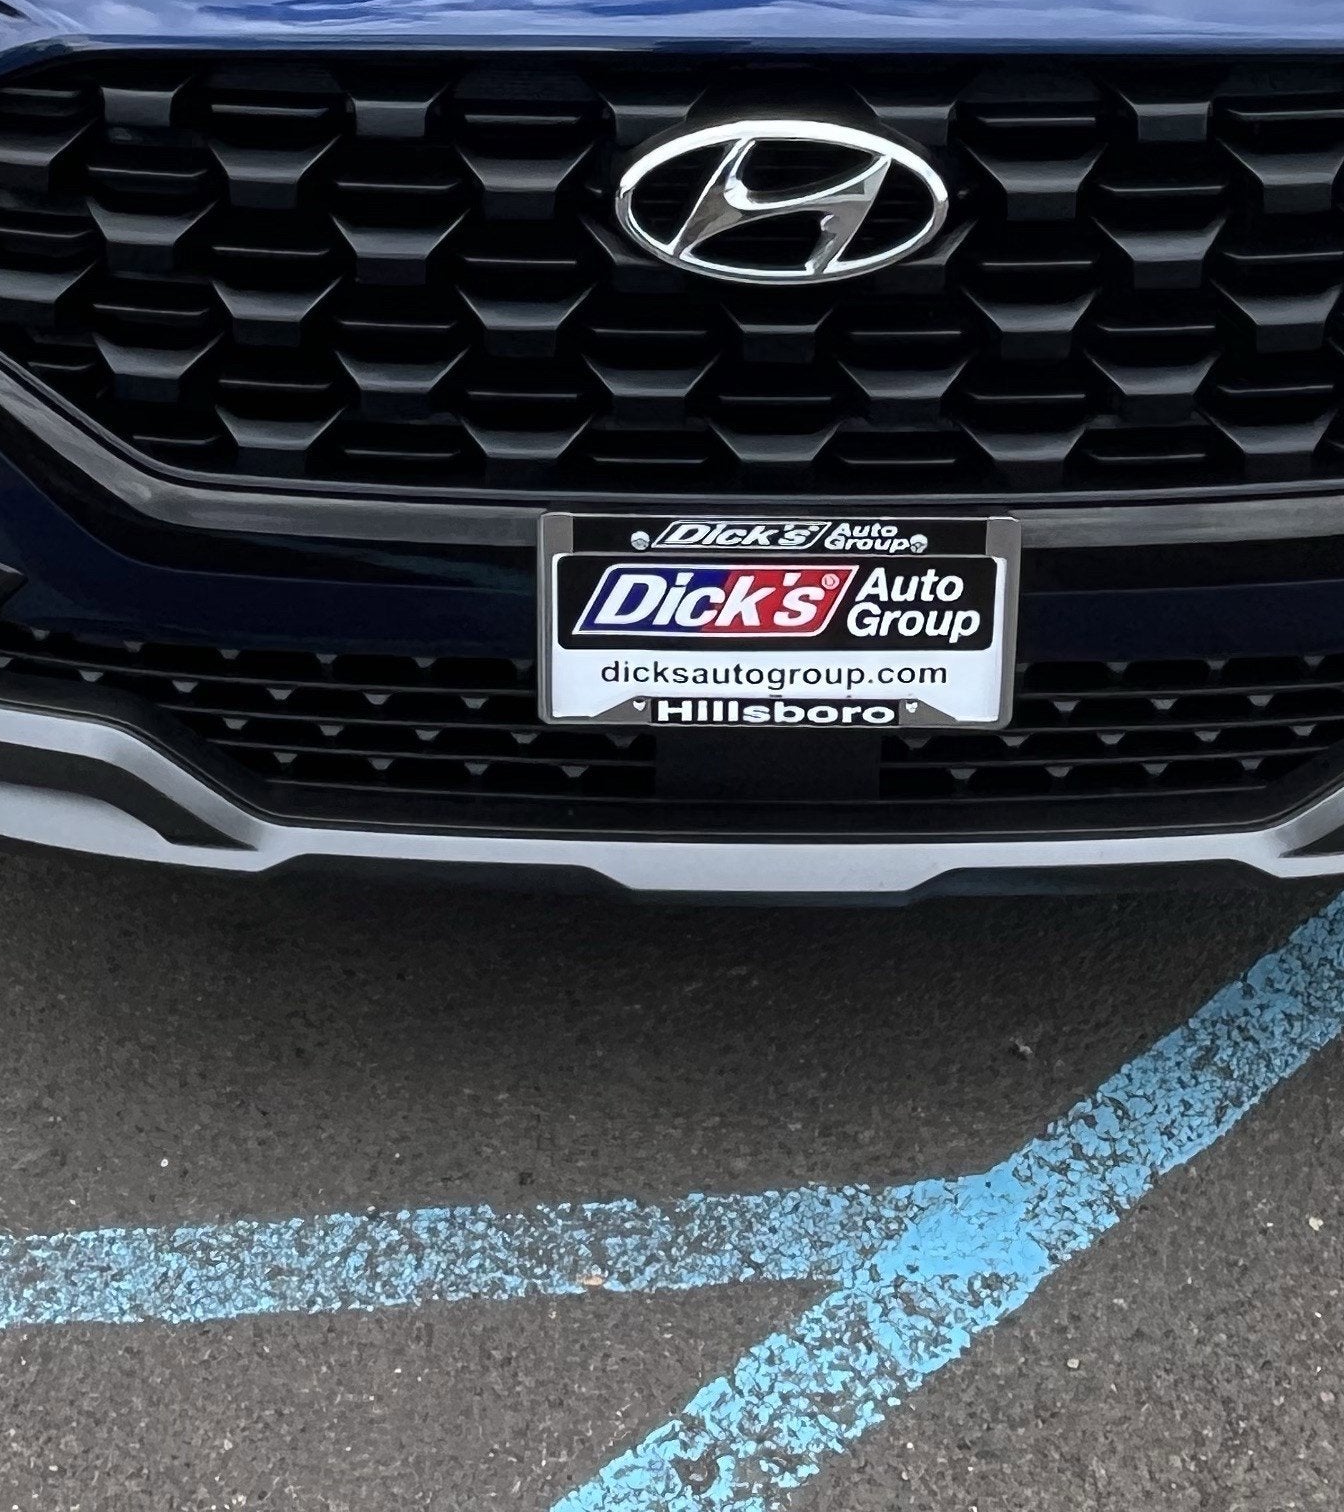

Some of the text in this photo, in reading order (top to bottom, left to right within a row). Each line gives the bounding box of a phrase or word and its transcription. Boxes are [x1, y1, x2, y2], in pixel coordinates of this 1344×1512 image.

[666, 523, 813, 547] Dick's
[829, 522, 899, 538] Auto
[823, 535, 911, 554] Group
[853, 566, 965, 604] Auto
[592, 571, 826, 630] Dick's
[846, 604, 982, 644] Group
[600, 660, 948, 690] dicksautogroup.com
[656, 700, 896, 724] Hillsboro
